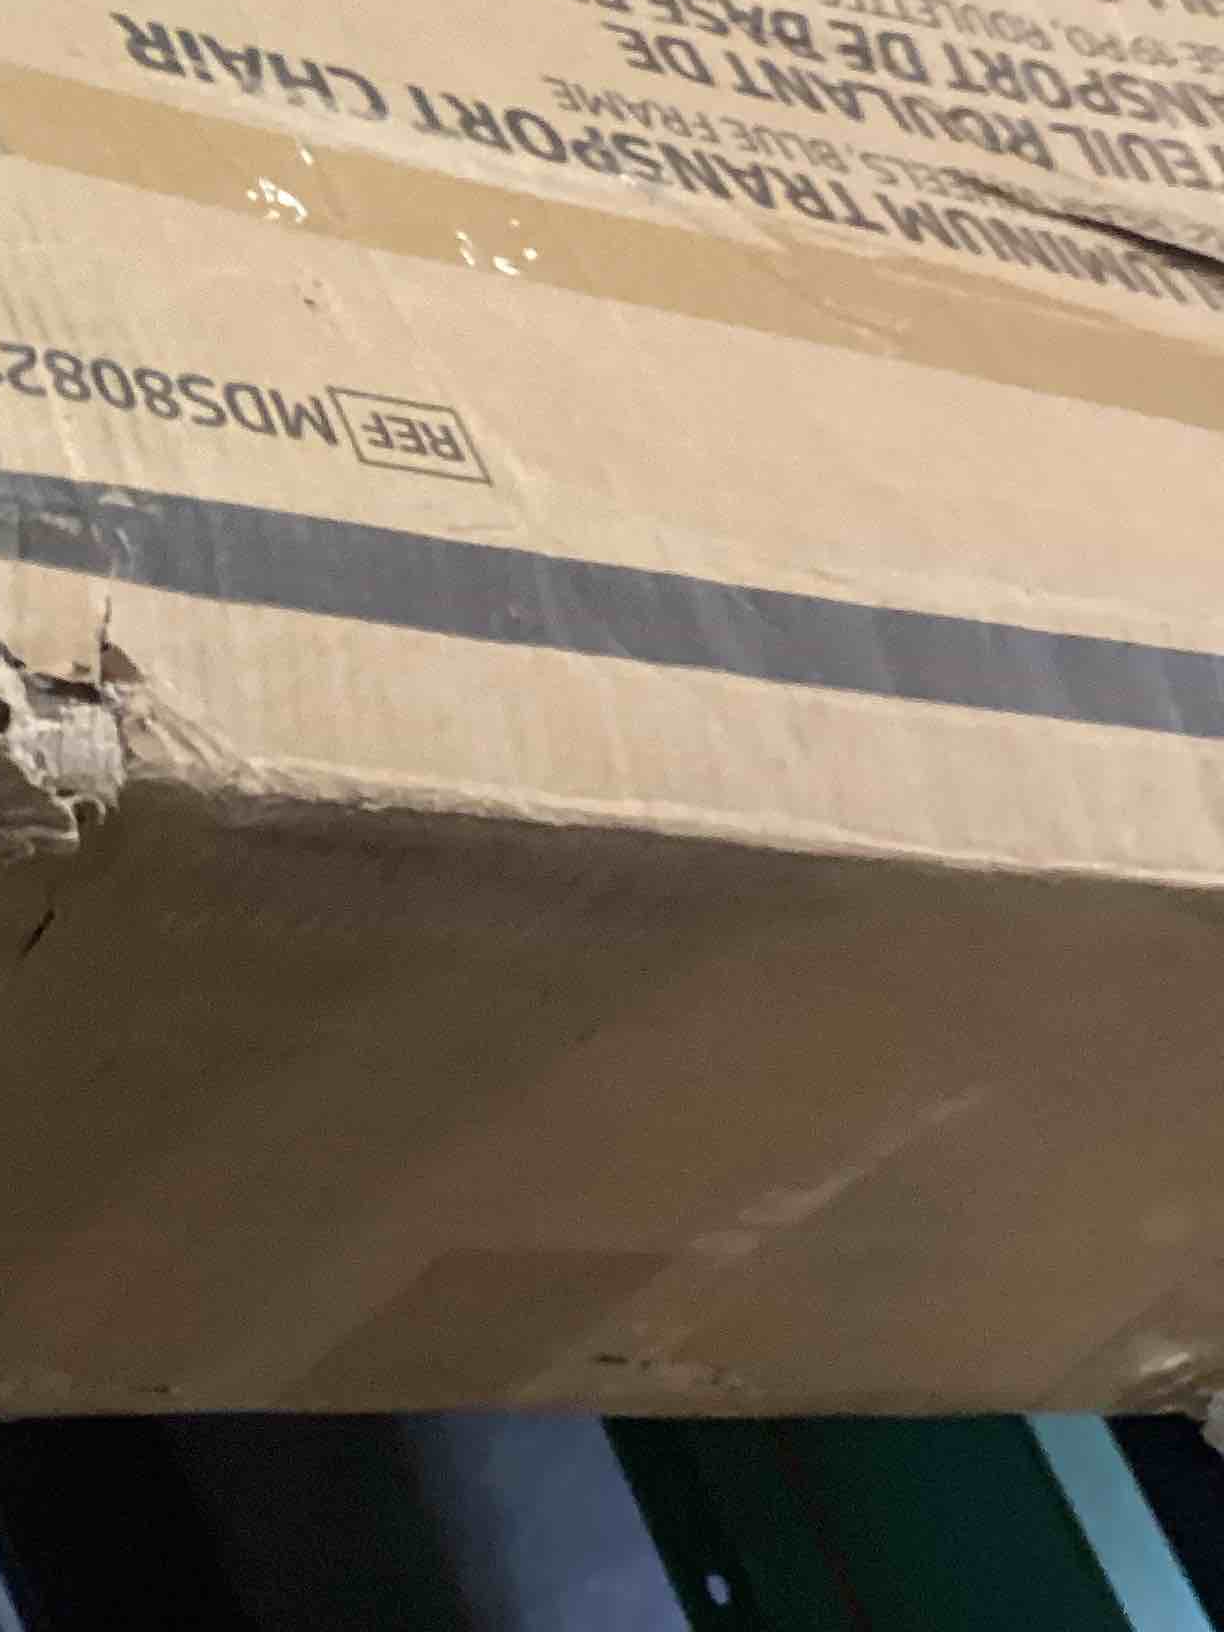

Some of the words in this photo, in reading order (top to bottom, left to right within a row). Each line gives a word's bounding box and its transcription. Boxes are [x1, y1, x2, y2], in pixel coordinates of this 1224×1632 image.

[601, 21, 715, 89] DE
[827, 20, 933, 86] DE
[541, 75, 721, 145] FRAME
[723, 50, 1057, 174] ROULANT
[408, 85, 890, 236] TRANSPORT
[720, 116, 851, 176] BLUE
[873, 193, 1224, 313] LUMINUM
[360, 410, 466, 465] REF
